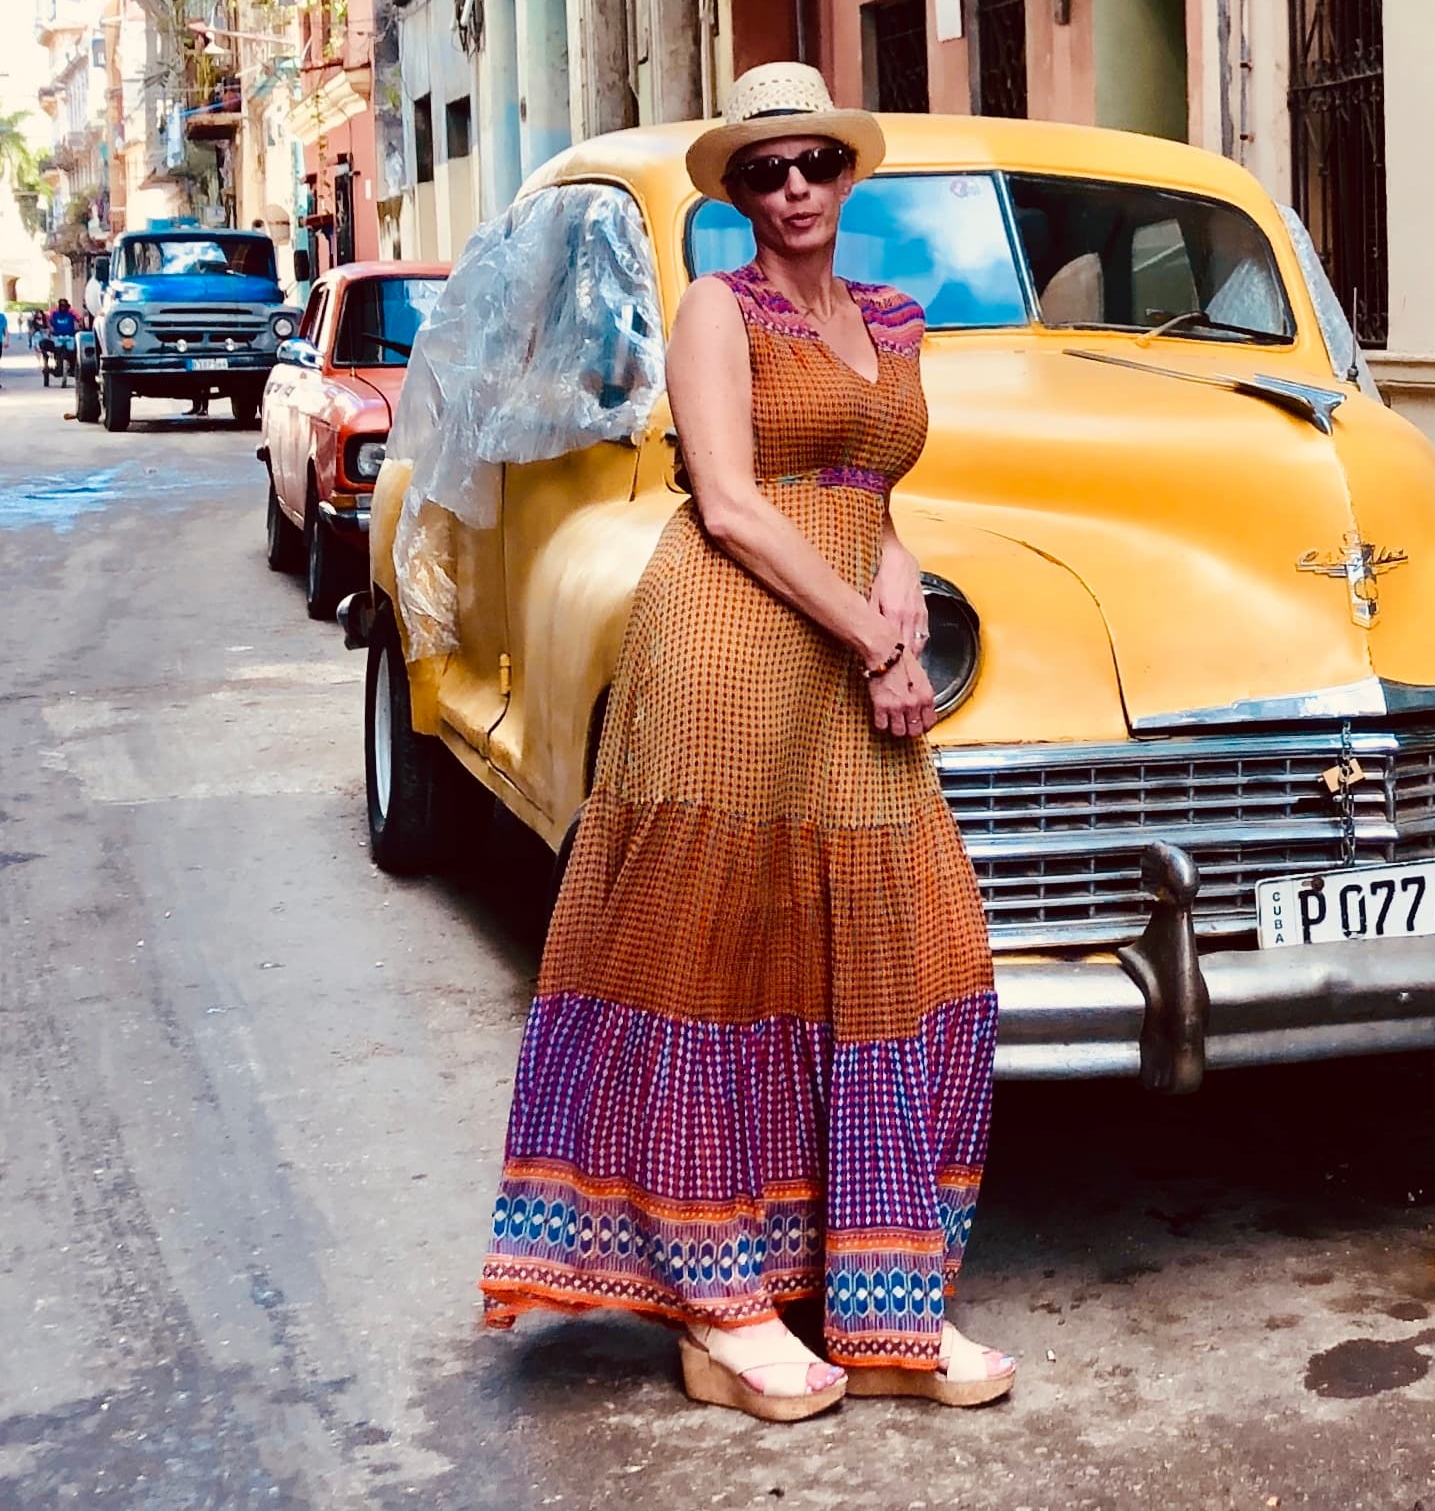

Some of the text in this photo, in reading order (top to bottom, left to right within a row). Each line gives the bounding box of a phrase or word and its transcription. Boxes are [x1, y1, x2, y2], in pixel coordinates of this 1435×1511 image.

[1272, 891, 1284, 944] CUBA
[1299, 889, 1326, 944] P
[1339, 875, 1426, 939] 077
